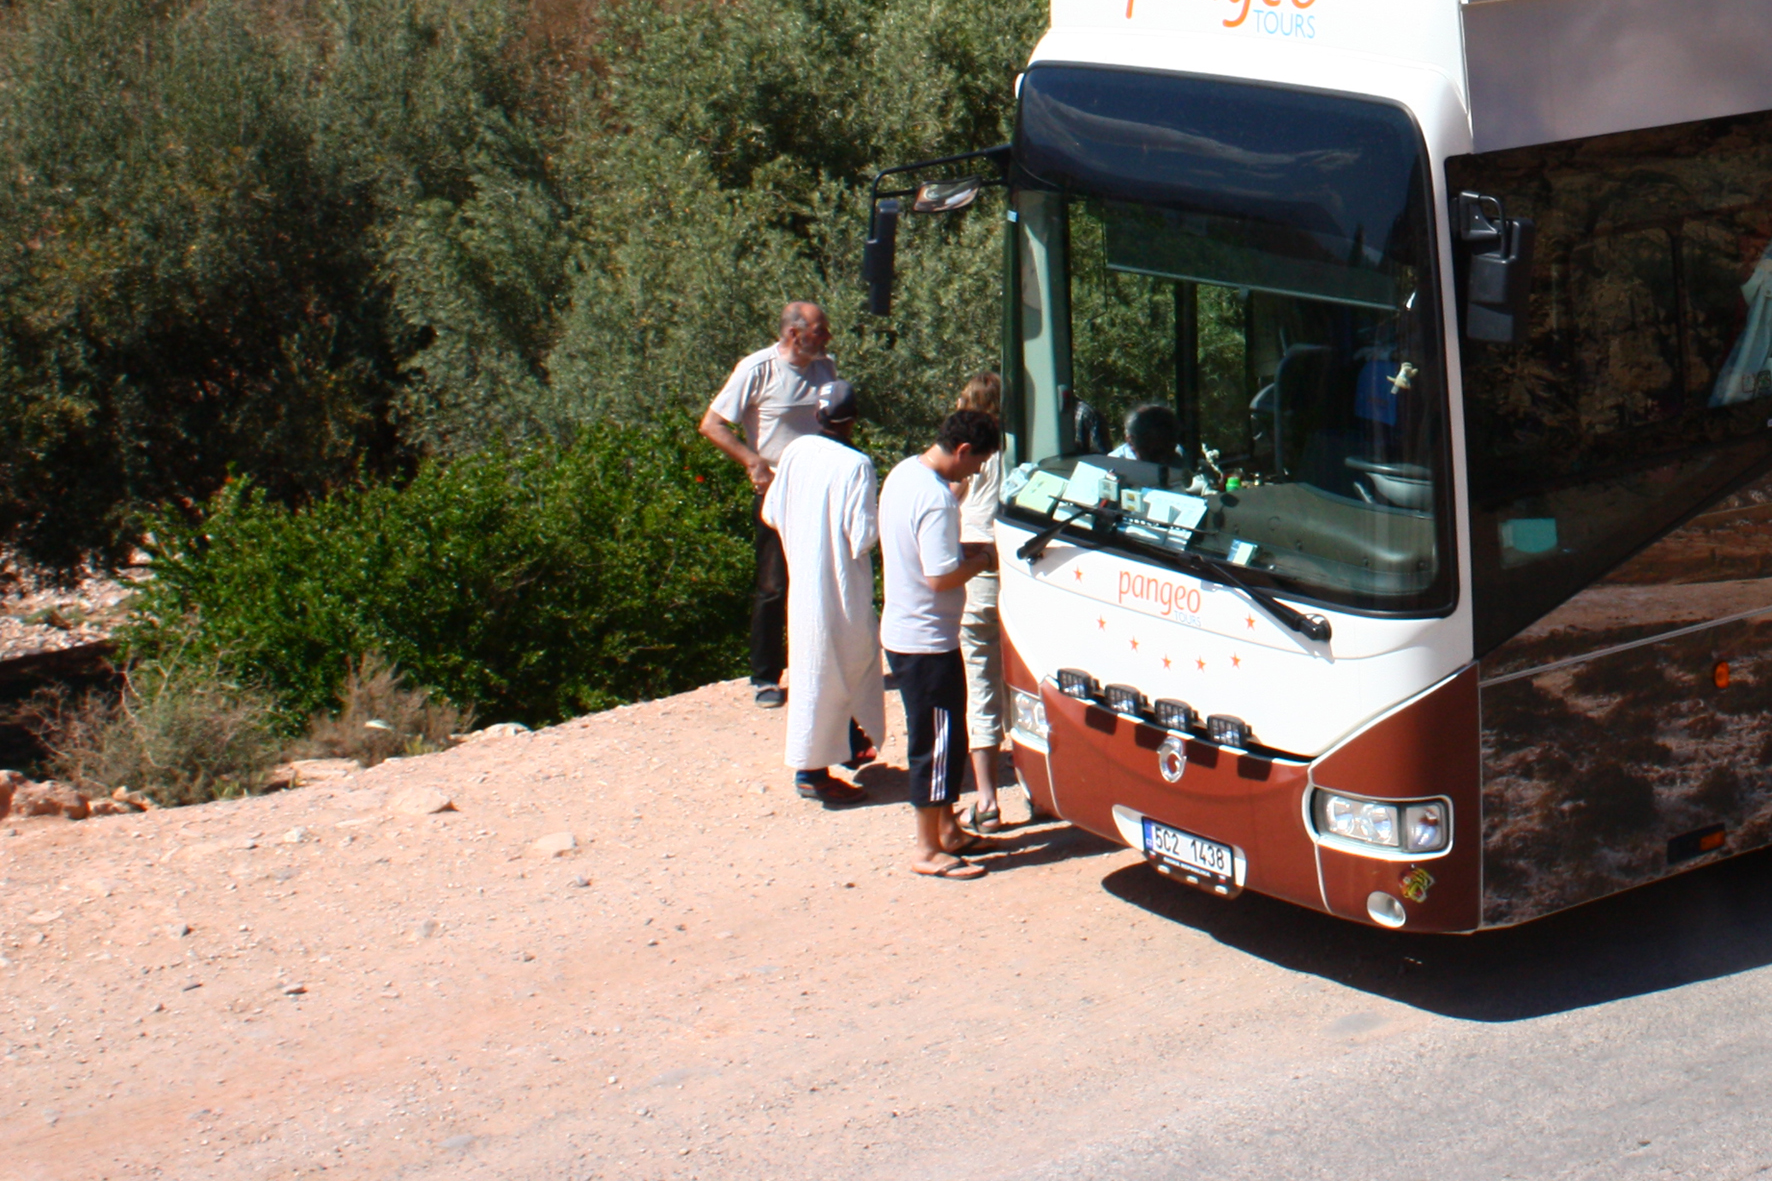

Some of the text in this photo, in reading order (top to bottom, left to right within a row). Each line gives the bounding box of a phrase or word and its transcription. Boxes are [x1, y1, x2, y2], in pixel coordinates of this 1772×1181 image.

[1253, 9, 1316, 39] TOURS
[1118, 570, 1201, 615] pangeo
[1174, 610, 1202, 627] TOURS
[1154, 826, 1180, 856] 5C2
[1190, 839, 1225, 870] 1438
